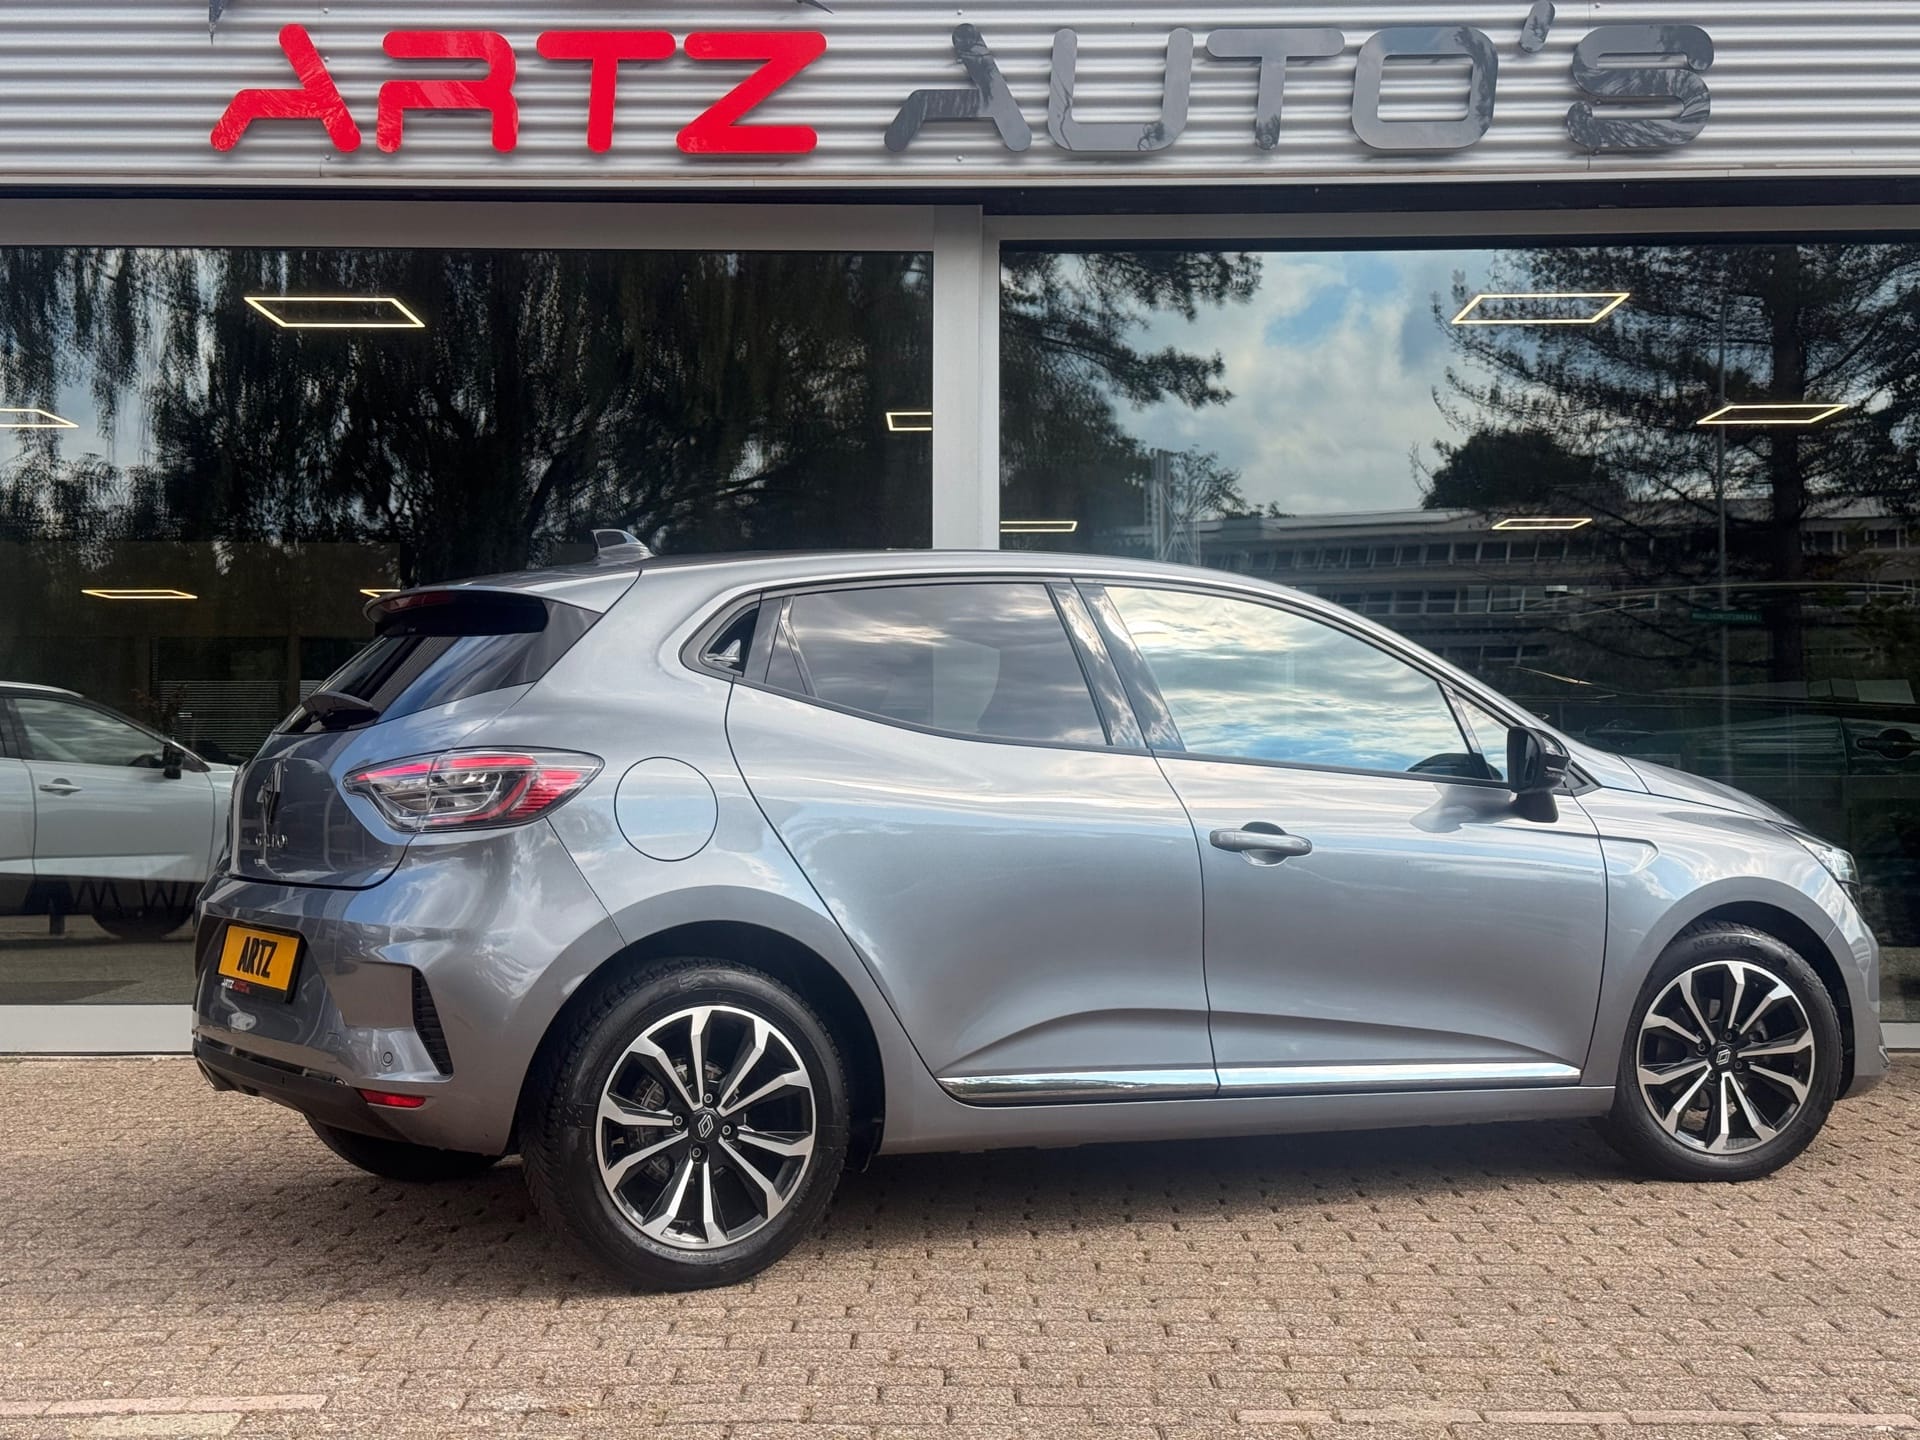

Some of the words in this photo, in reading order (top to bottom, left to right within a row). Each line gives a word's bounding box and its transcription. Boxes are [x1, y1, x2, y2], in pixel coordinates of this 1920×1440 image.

[211, 24, 827, 153] ARTZ
[884, 0, 1714, 152] AUTO'S
[236, 936, 278, 978] ARTZ
